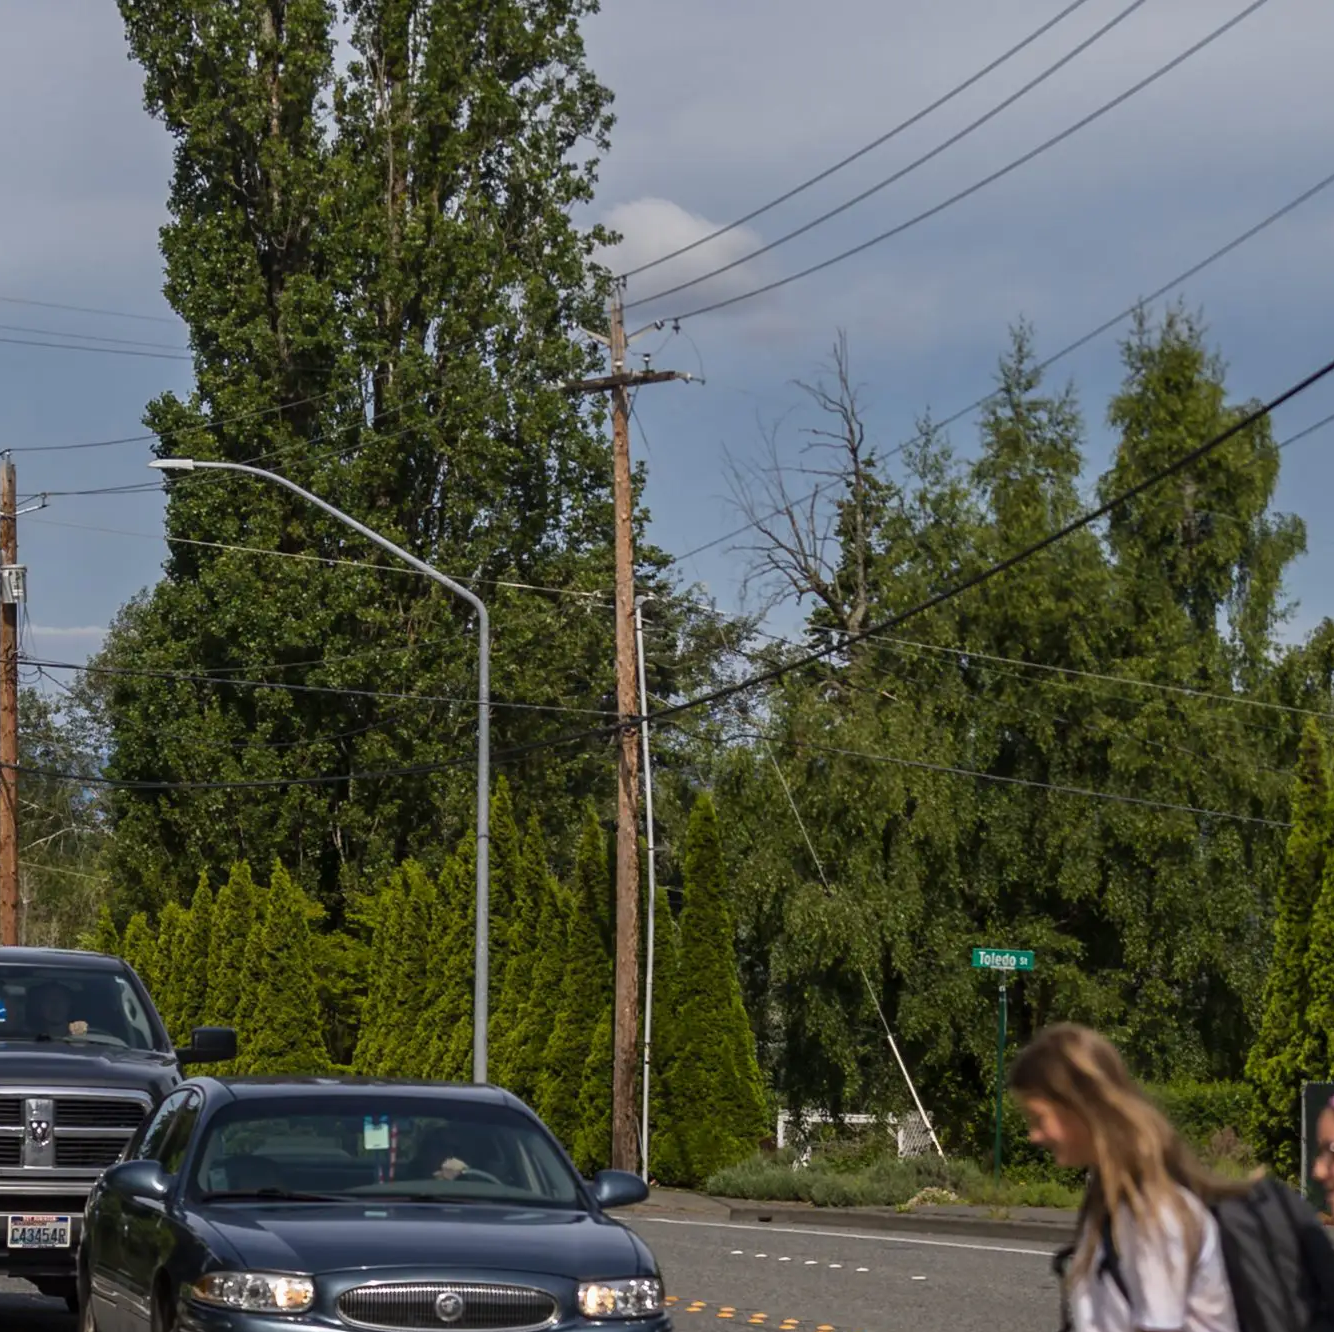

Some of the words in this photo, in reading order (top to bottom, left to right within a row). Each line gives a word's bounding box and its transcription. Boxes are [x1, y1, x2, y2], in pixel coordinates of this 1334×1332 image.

[978, 951, 1016, 966] Toledo
[1019, 956, 1028, 966] St
[11, 1227, 67, 1243] C43454R
